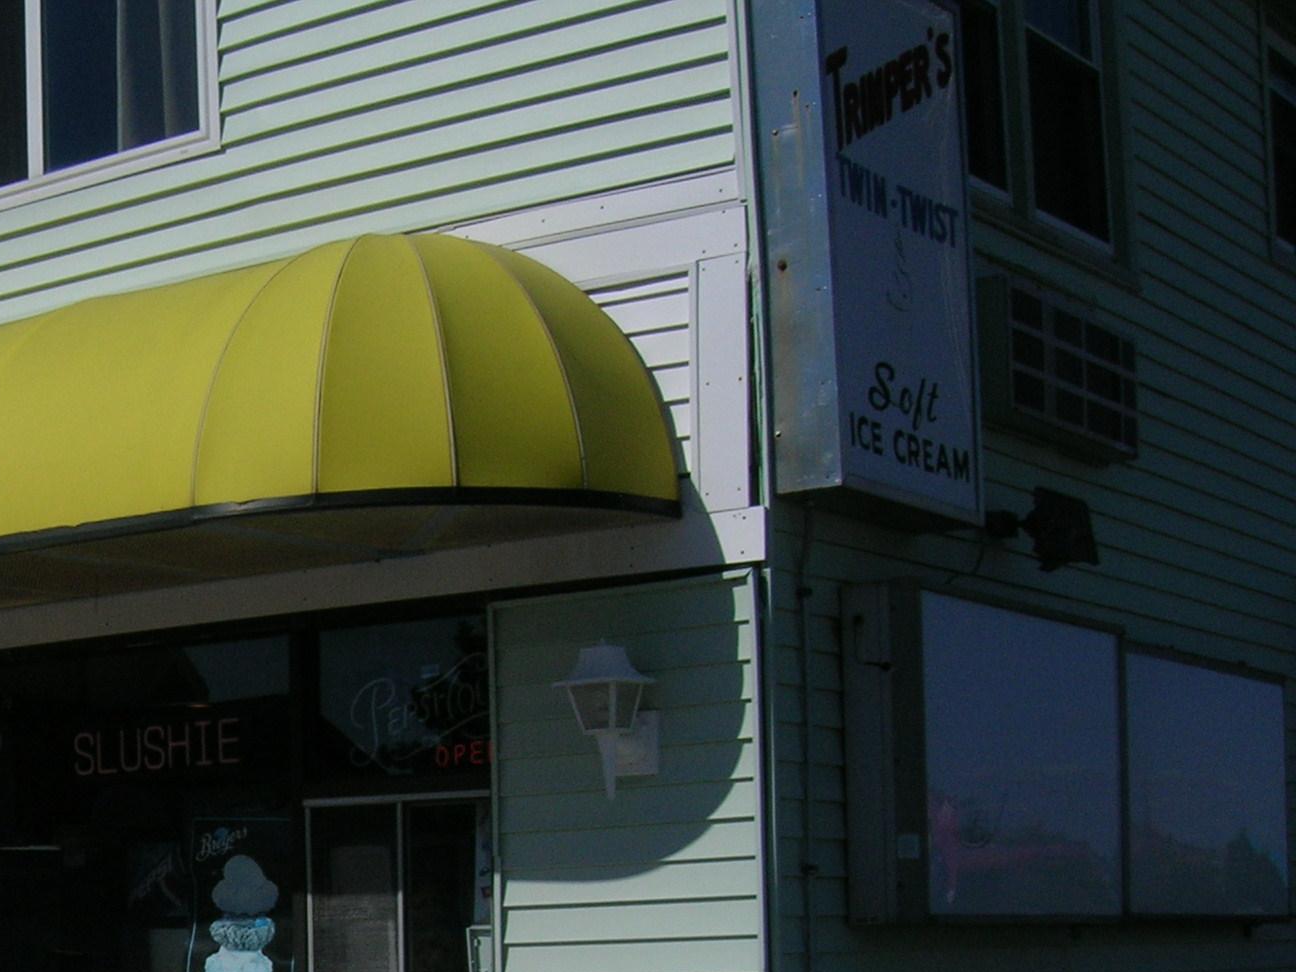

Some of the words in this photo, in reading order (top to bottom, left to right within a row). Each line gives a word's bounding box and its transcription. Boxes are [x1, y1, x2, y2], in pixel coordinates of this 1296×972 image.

[869, 362, 939, 430] Soft
[850, 412, 884, 456] ICE
[894, 430, 970, 482] CREAM
[72, 716, 240, 777] SLUSHIE
